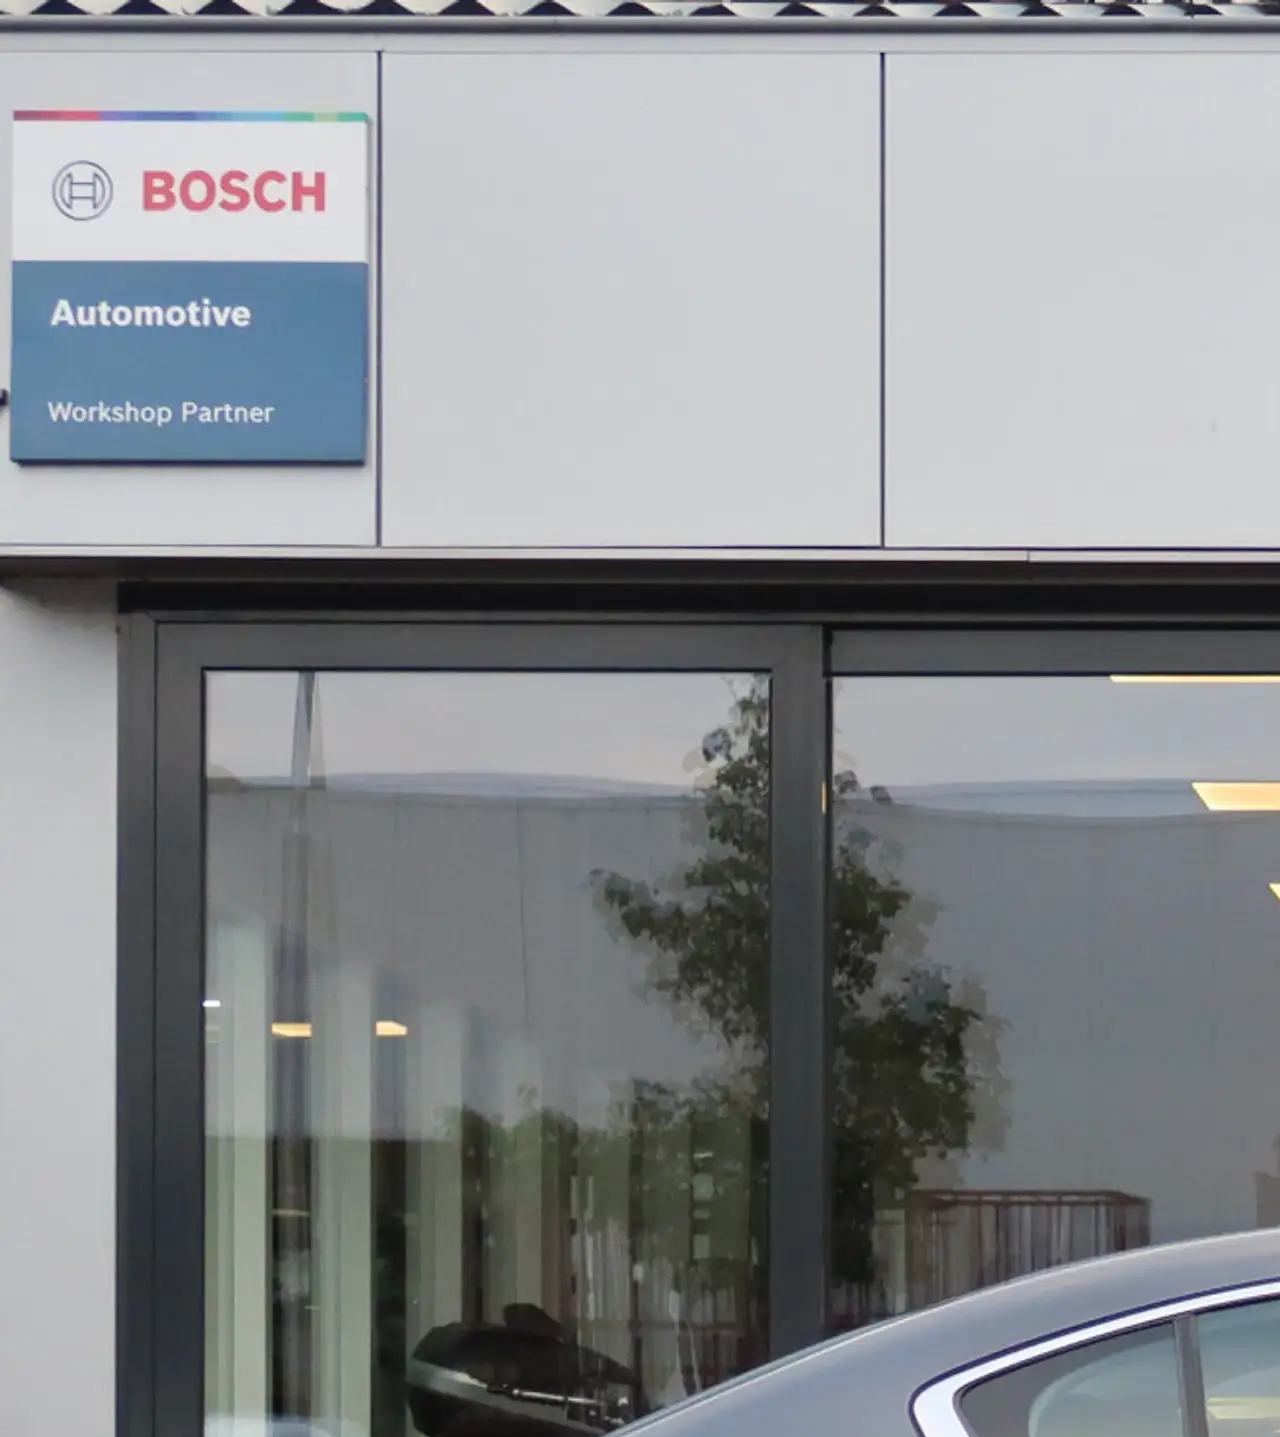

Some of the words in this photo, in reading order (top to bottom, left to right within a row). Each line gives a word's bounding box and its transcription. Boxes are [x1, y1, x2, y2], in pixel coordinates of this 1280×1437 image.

[142, 170, 326, 212] BOSCH
[51, 299, 251, 327] Automotive
[48, 402, 173, 426] Workshop
[182, 402, 275, 424] Partner
